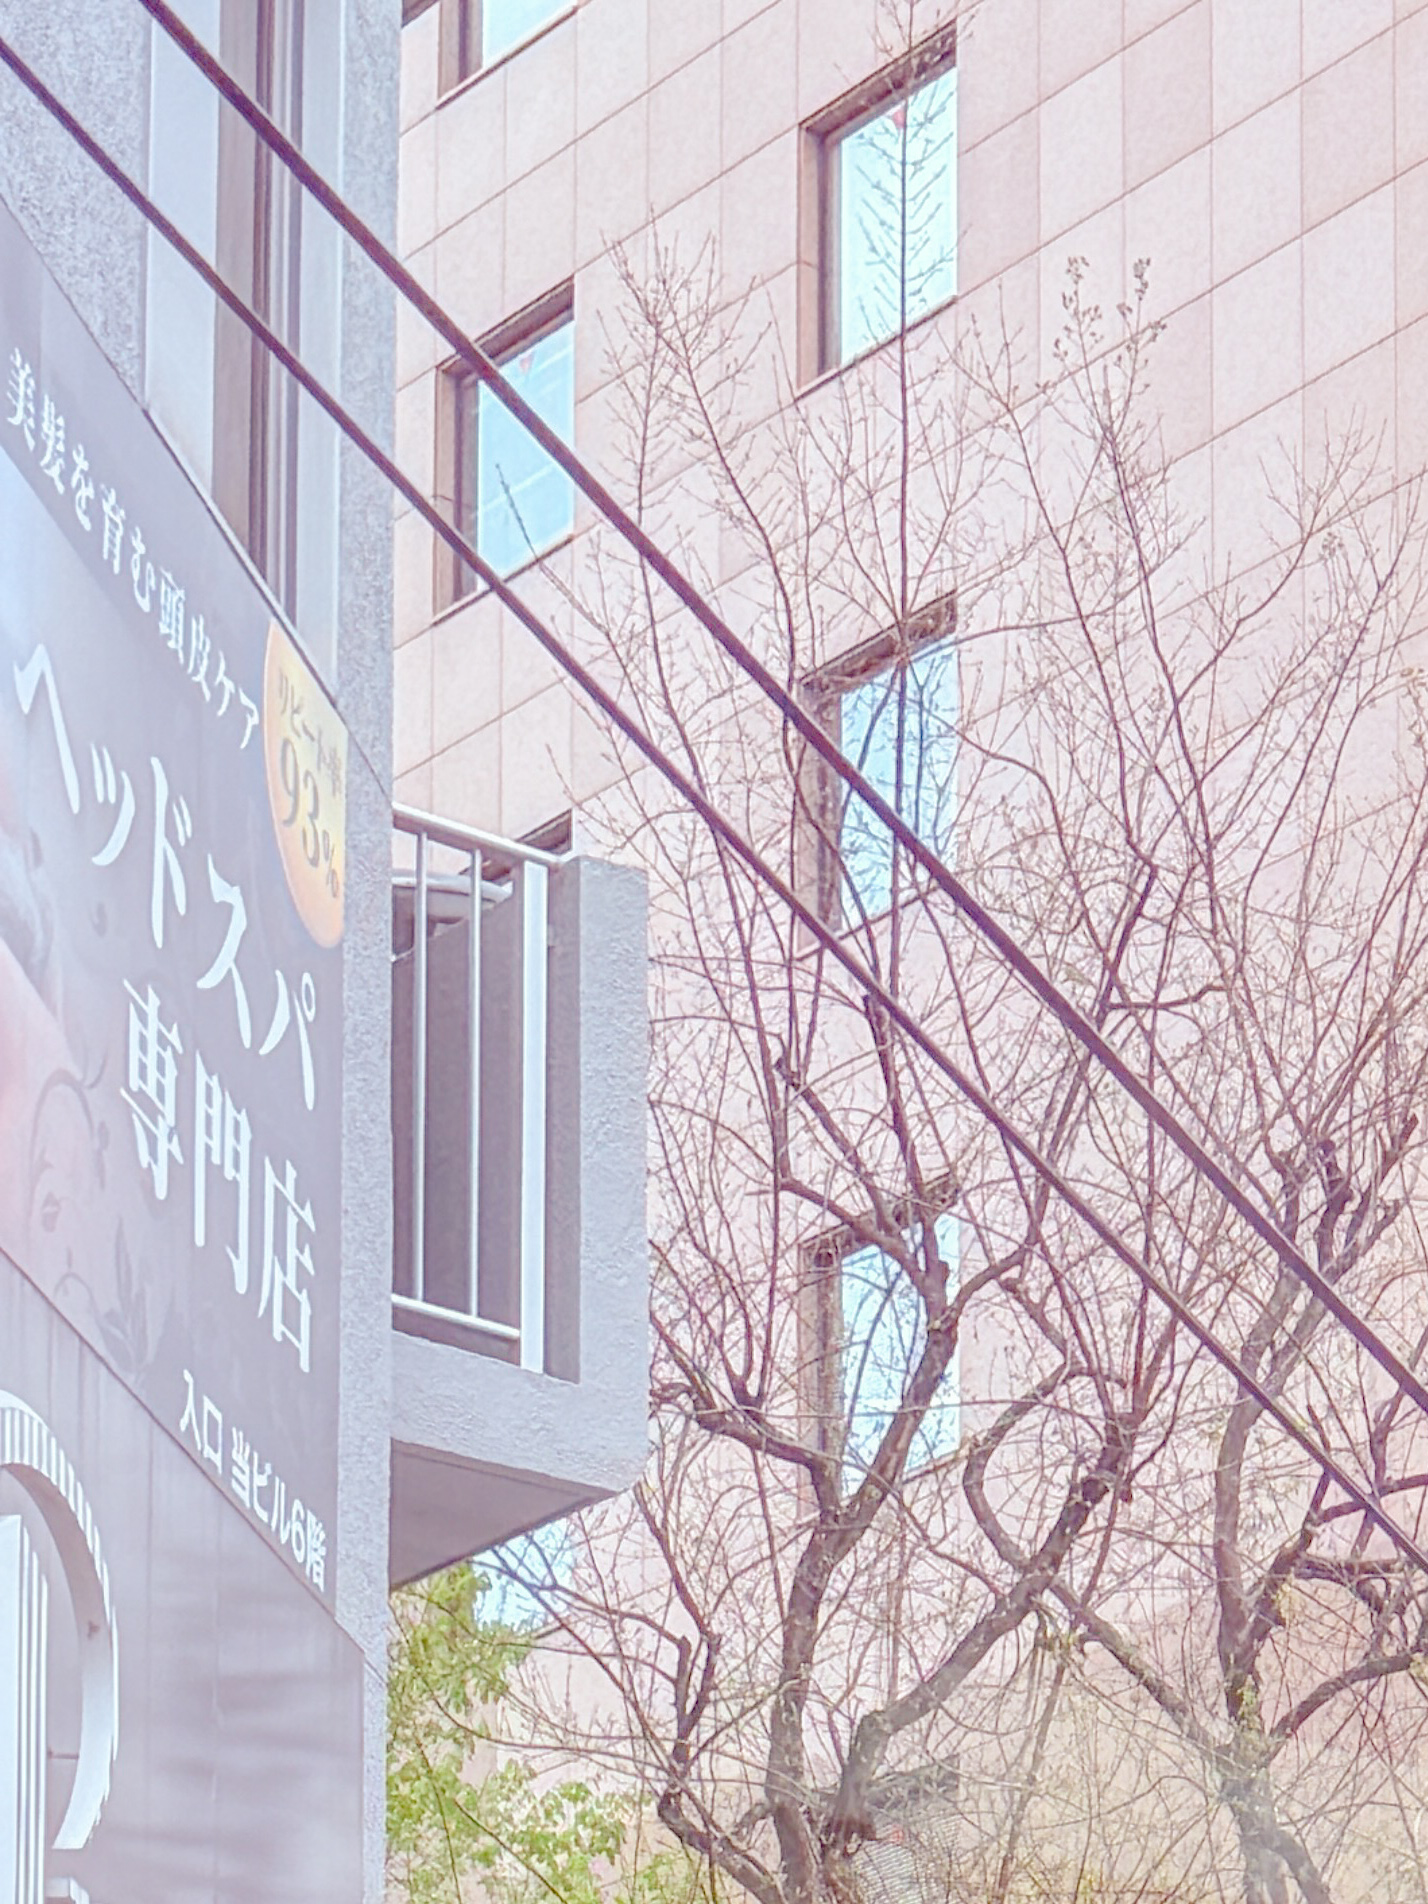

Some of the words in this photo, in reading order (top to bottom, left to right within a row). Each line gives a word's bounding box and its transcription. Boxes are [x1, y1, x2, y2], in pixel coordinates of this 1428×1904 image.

[13, 643, 317, 1112] ヘッドスパ
[120, 977, 317, 1374] 専門店
[180, 1368, 224, 1476] 入口
[230, 1427, 327, 1594] 当ビル6階
